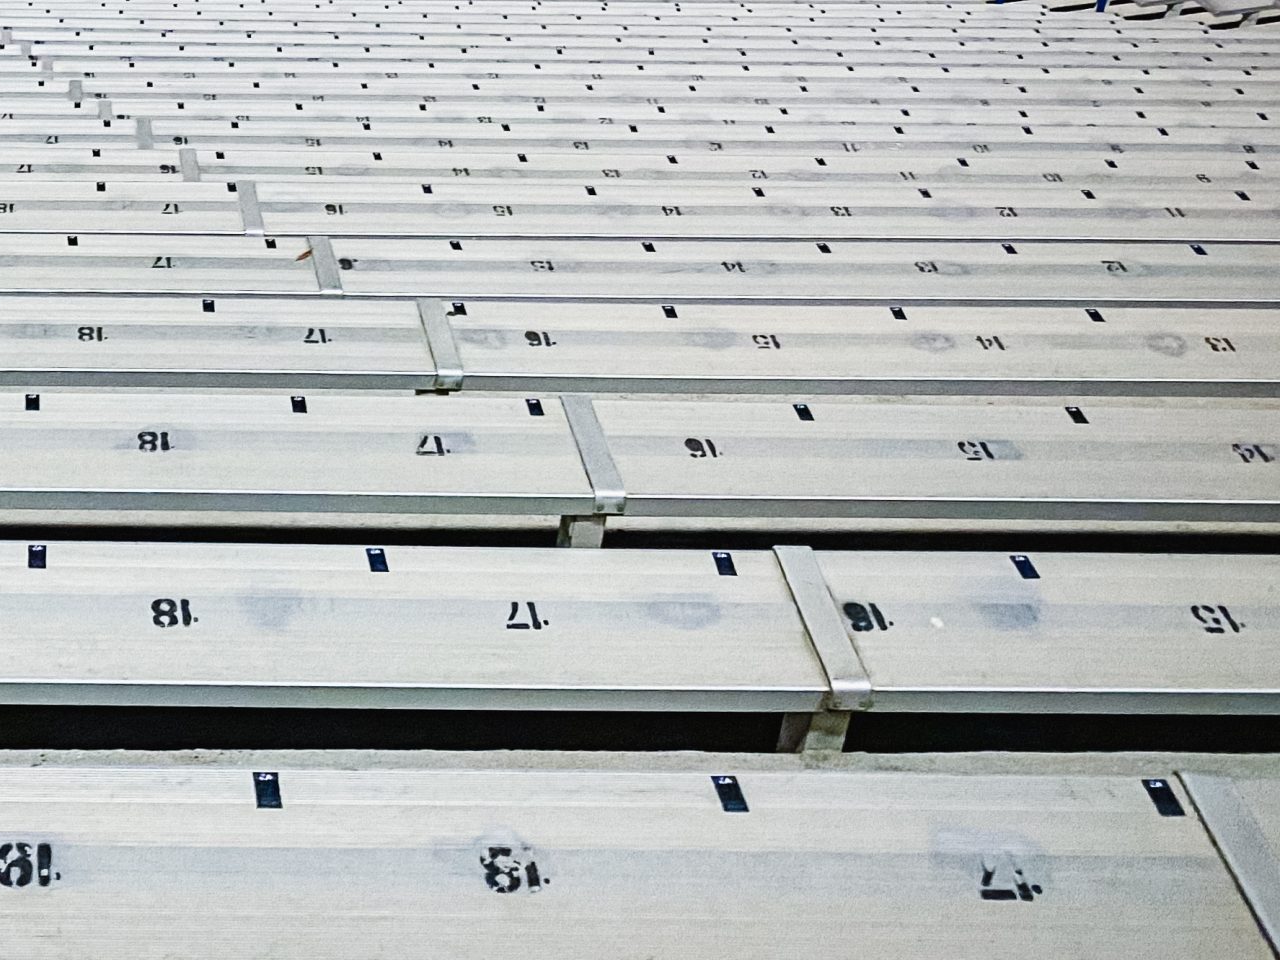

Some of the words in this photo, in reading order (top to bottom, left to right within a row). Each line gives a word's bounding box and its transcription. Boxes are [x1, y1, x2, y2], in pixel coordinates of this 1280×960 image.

[16, 164, 33, 173] 17
[160, 165, 179, 173] 16
[305, 167, 323, 175] 15
[452, 168, 470, 176] 14
[749, 170, 768, 179] 12
[900, 172, 915, 180] 11
[163, 204, 179, 214] 17
[325, 204, 343, 214] 16
[493, 206, 512, 216] 15
[662, 206, 682, 216] 14
[830, 207, 852, 216] 13
[995, 207, 1018, 217] 12
[1164, 208, 1186, 217] 11
[152, 257, 172, 268] 17
[338, 258, 358, 270] 6
[530, 261, 554, 271] 15
[721, 262, 745, 272] 14
[915, 262, 938, 273] 13
[1102, 261, 1127, 272] 12
[78, 327, 102, 341] 18
[304, 328, 332, 343] 17
[525, 331, 556, 346] 16
[752, 335, 780, 349] 15
[976, 336, 1005, 350] 14
[1205, 337, 1235, 351] 13
[138, 432, 170, 452] 18
[416, 435, 450, 456] 17
[685, 438, 717, 458] 16
[958, 441, 994, 460] 15
[151, 599, 202, 627] 18
[507, 602, 553, 629] 17
[842, 602, 888, 632] 16
[1191, 605, 1249, 633] 15
[980, 858, 1042, 901] 17
